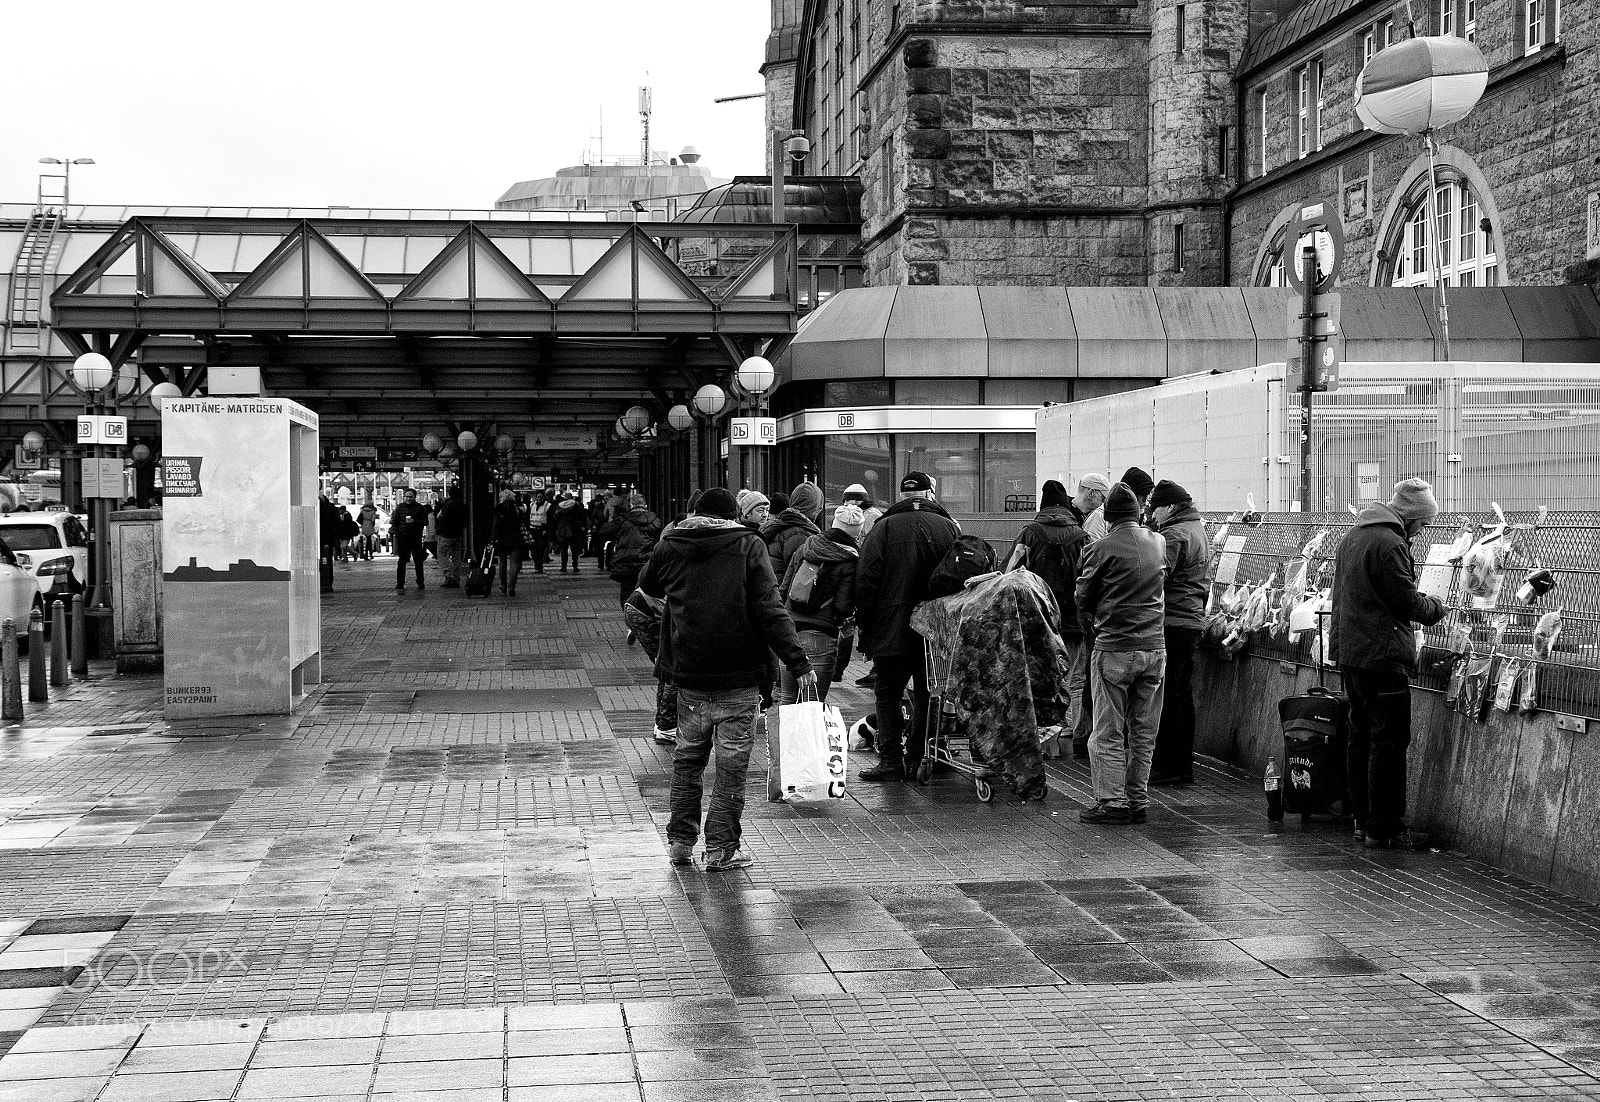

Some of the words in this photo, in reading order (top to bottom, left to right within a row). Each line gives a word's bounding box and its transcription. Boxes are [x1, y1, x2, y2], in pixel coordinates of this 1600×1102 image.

[227, 404, 283, 414] MATROSEN
[839, 416, 853, 426] DB
[166, 459, 190, 467] URINAL
[167, 686, 211, 695] BUNKER93
[167, 695, 218, 704] EASY2PAINT
